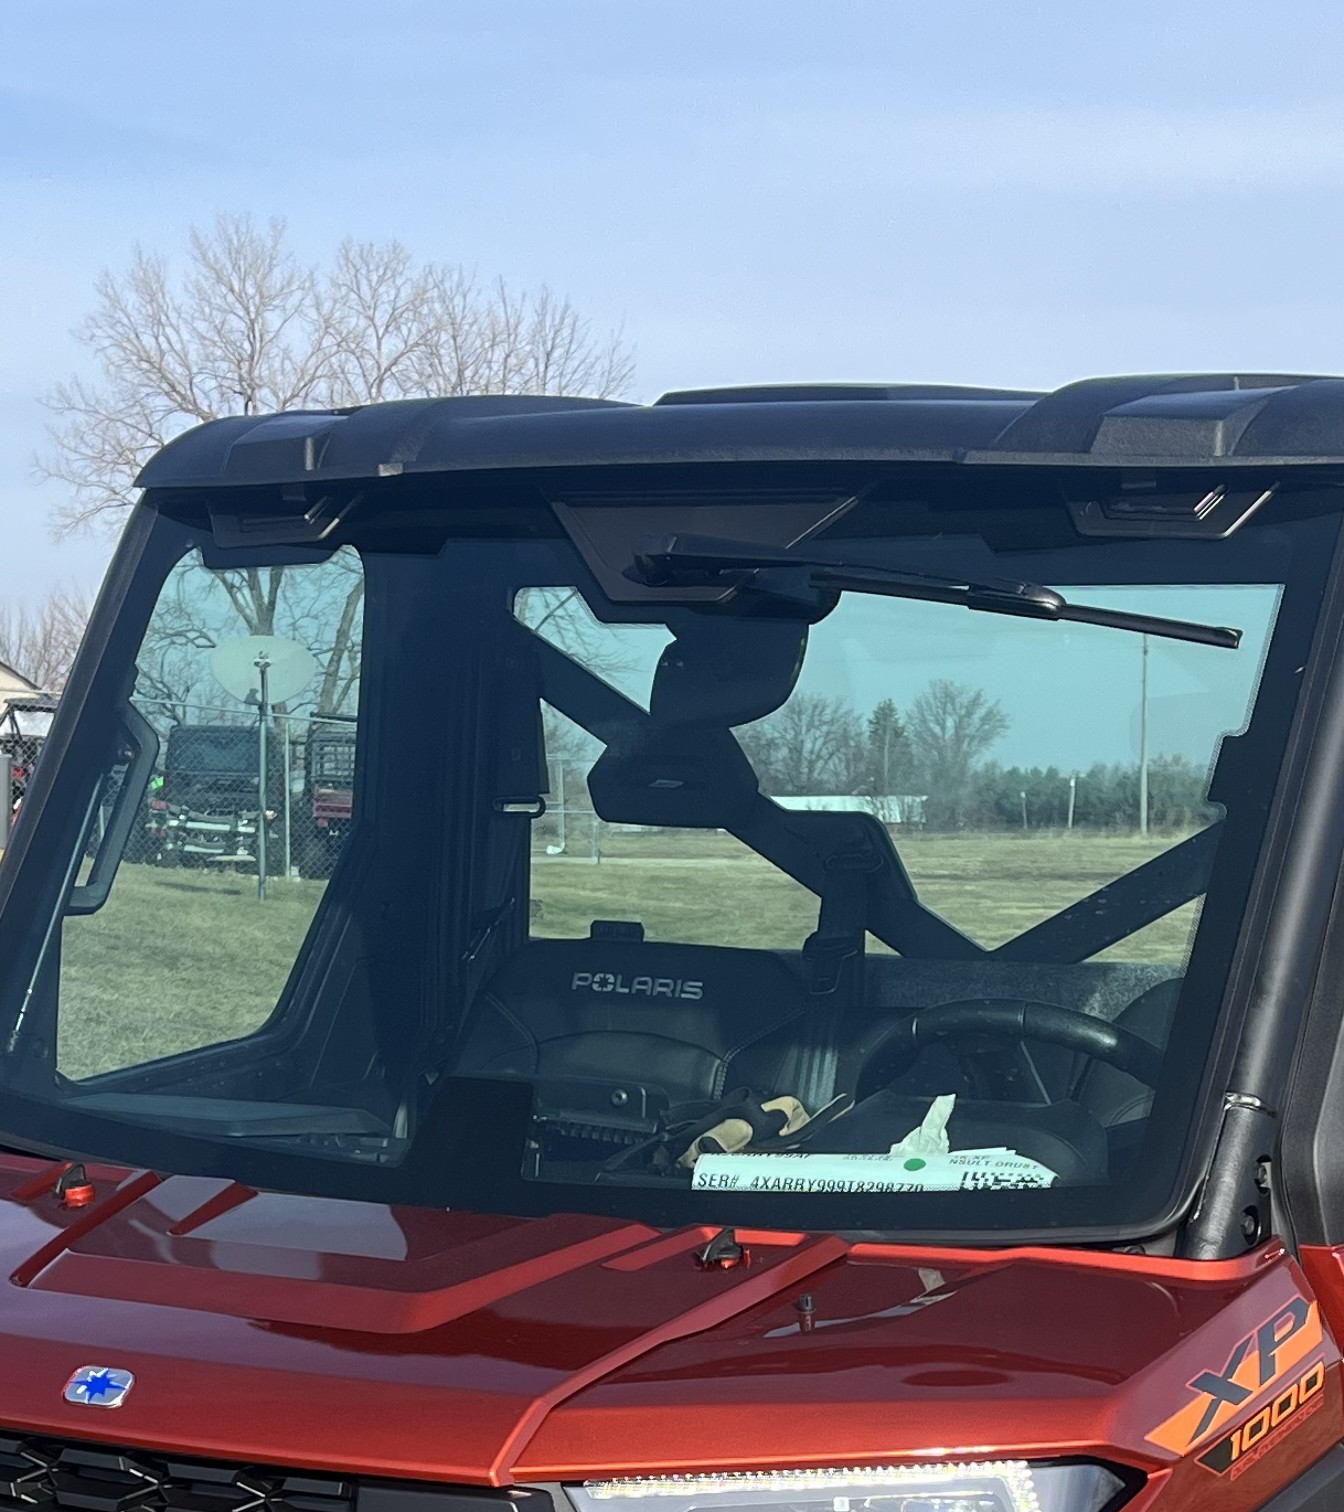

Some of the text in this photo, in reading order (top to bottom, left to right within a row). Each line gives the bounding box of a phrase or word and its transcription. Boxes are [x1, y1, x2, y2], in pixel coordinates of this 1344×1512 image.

[571, 972, 704, 1000] POLARIS
[697, 1172, 739, 1190] SER#
[1186, 1295, 1311, 1448] XP
[1229, 1361, 1326, 1461] 1000
